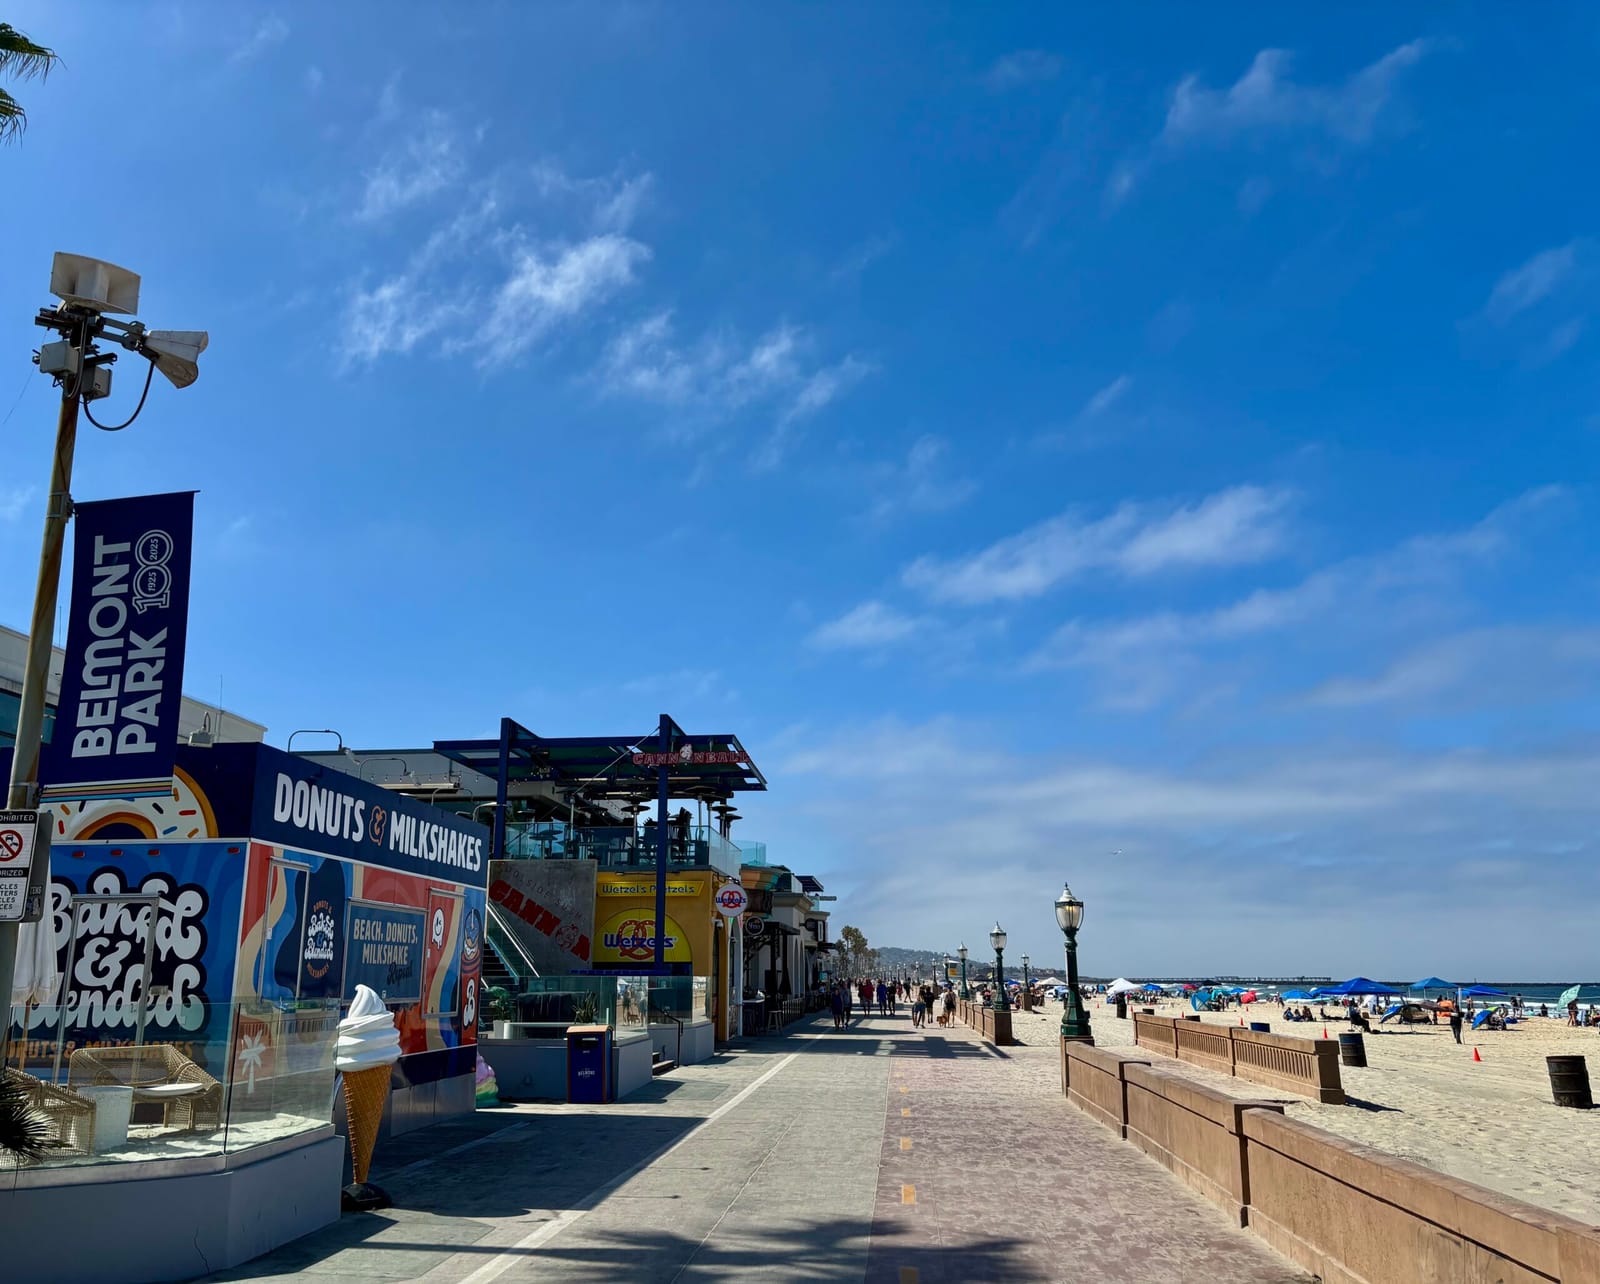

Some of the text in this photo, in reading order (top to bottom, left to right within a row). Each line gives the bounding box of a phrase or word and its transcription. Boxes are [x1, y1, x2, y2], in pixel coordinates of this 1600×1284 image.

[149, 538, 159, 561] 2025
[132, 529, 174, 615] 100
[147, 571, 157, 592] 1925
[71, 535, 131, 758] BELMONT
[115, 627, 168, 755] PARK
[274, 772, 365, 842] DONUTS
[389, 811, 482, 872] MILKSHAKES
[602, 885, 647, 893] Wetzel's
[353, 918, 418, 944] BEACH, DONUTS,
[75, 937, 131, 990] &
[362, 943, 409, 965] MILKSHAKE
